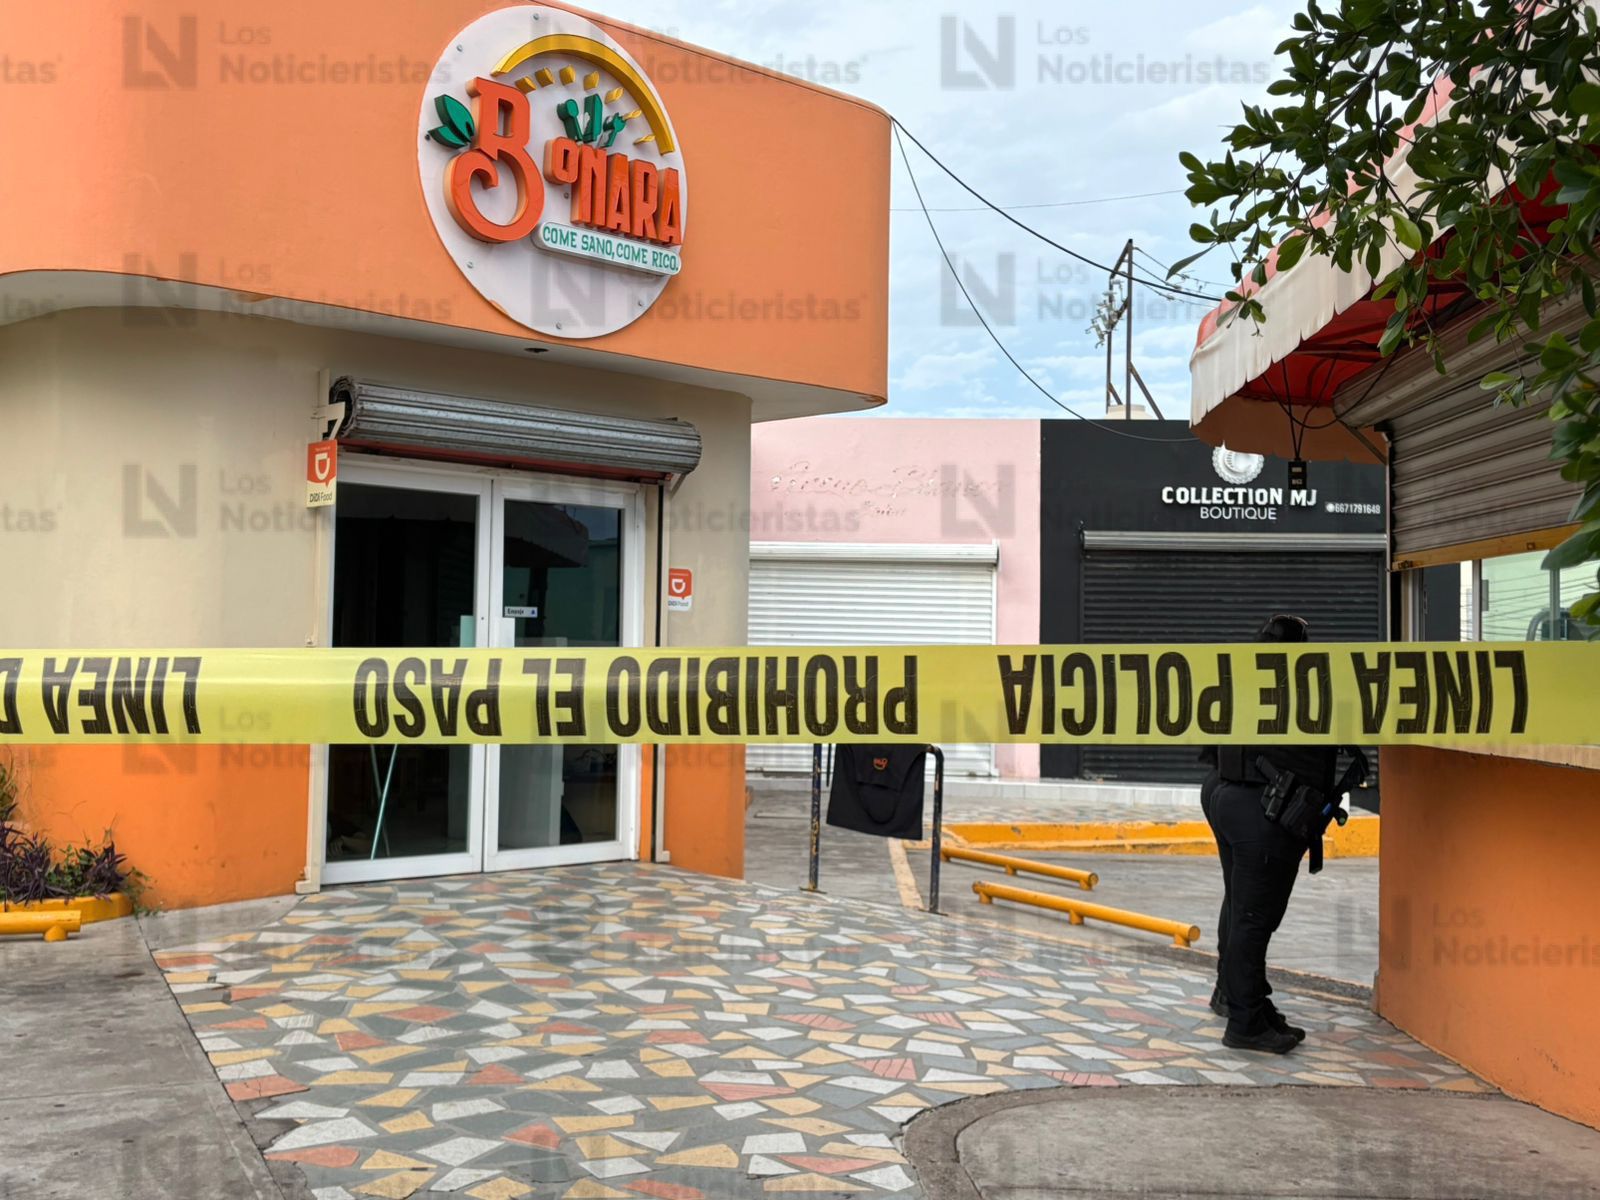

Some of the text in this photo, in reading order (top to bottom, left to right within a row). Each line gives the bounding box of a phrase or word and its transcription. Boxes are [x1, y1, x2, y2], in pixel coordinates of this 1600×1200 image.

[542, 227, 578, 249] COME
[615, 243, 648, 265] COME
[651, 250, 680, 271] RICO.
[1161, 486, 1317, 506] COLLECTION MJ
[1200, 507, 1277, 520] BOUTIQUE
[41, 656, 203, 735] LINEA
[353, 654, 919, 739] PROHIBIDO EL PASO
[997, 650, 1529, 737] LINEA DE POLICIA
